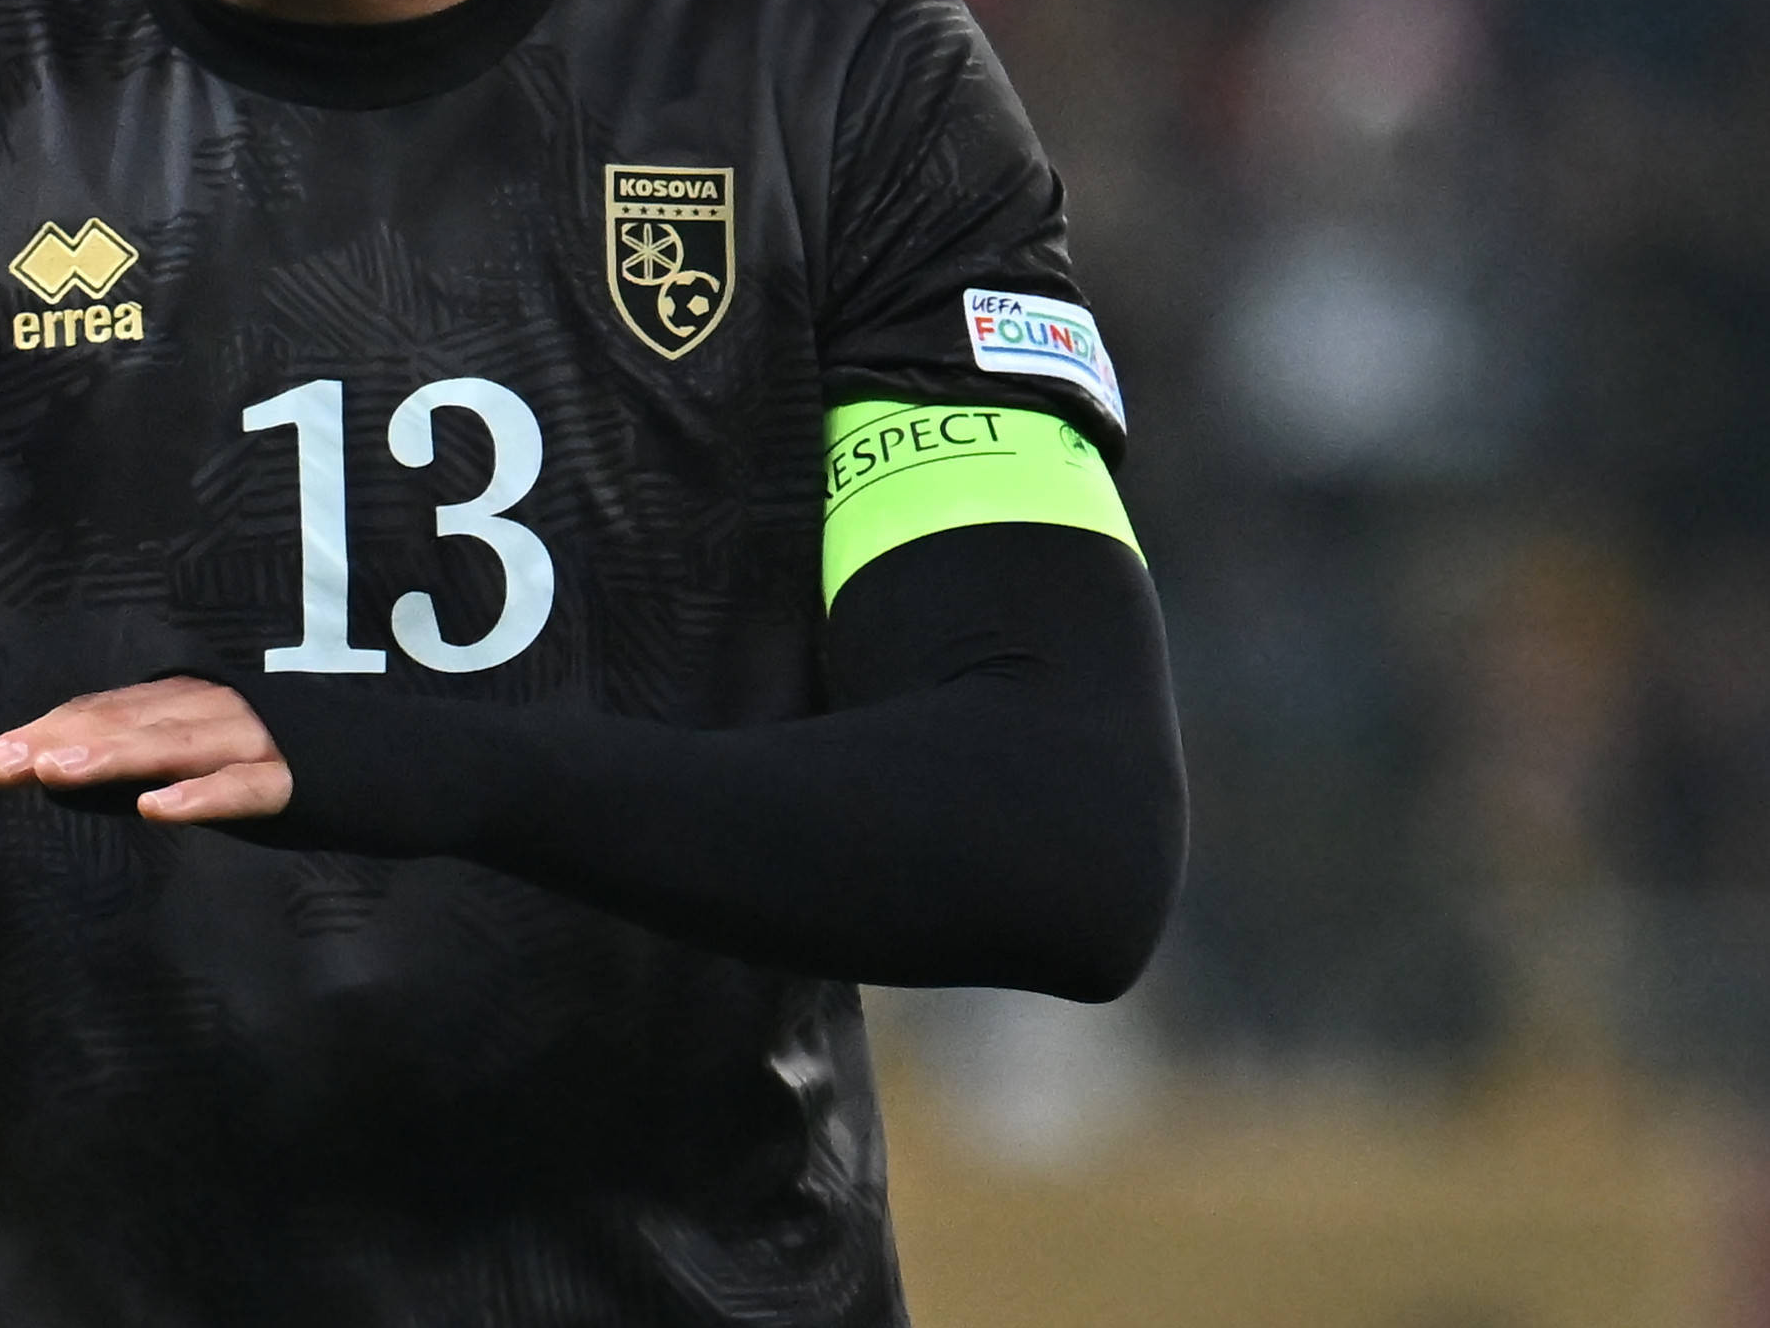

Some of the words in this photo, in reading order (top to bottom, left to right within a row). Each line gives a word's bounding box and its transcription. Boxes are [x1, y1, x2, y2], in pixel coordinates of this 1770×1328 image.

[619, 177, 719, 200] KOSOVA
[971, 294, 1023, 315] UEFA
[973, 315, 1099, 365] FOUND
[823, 412, 1002, 500] ESPECT
[241, 376, 556, 674] 13
